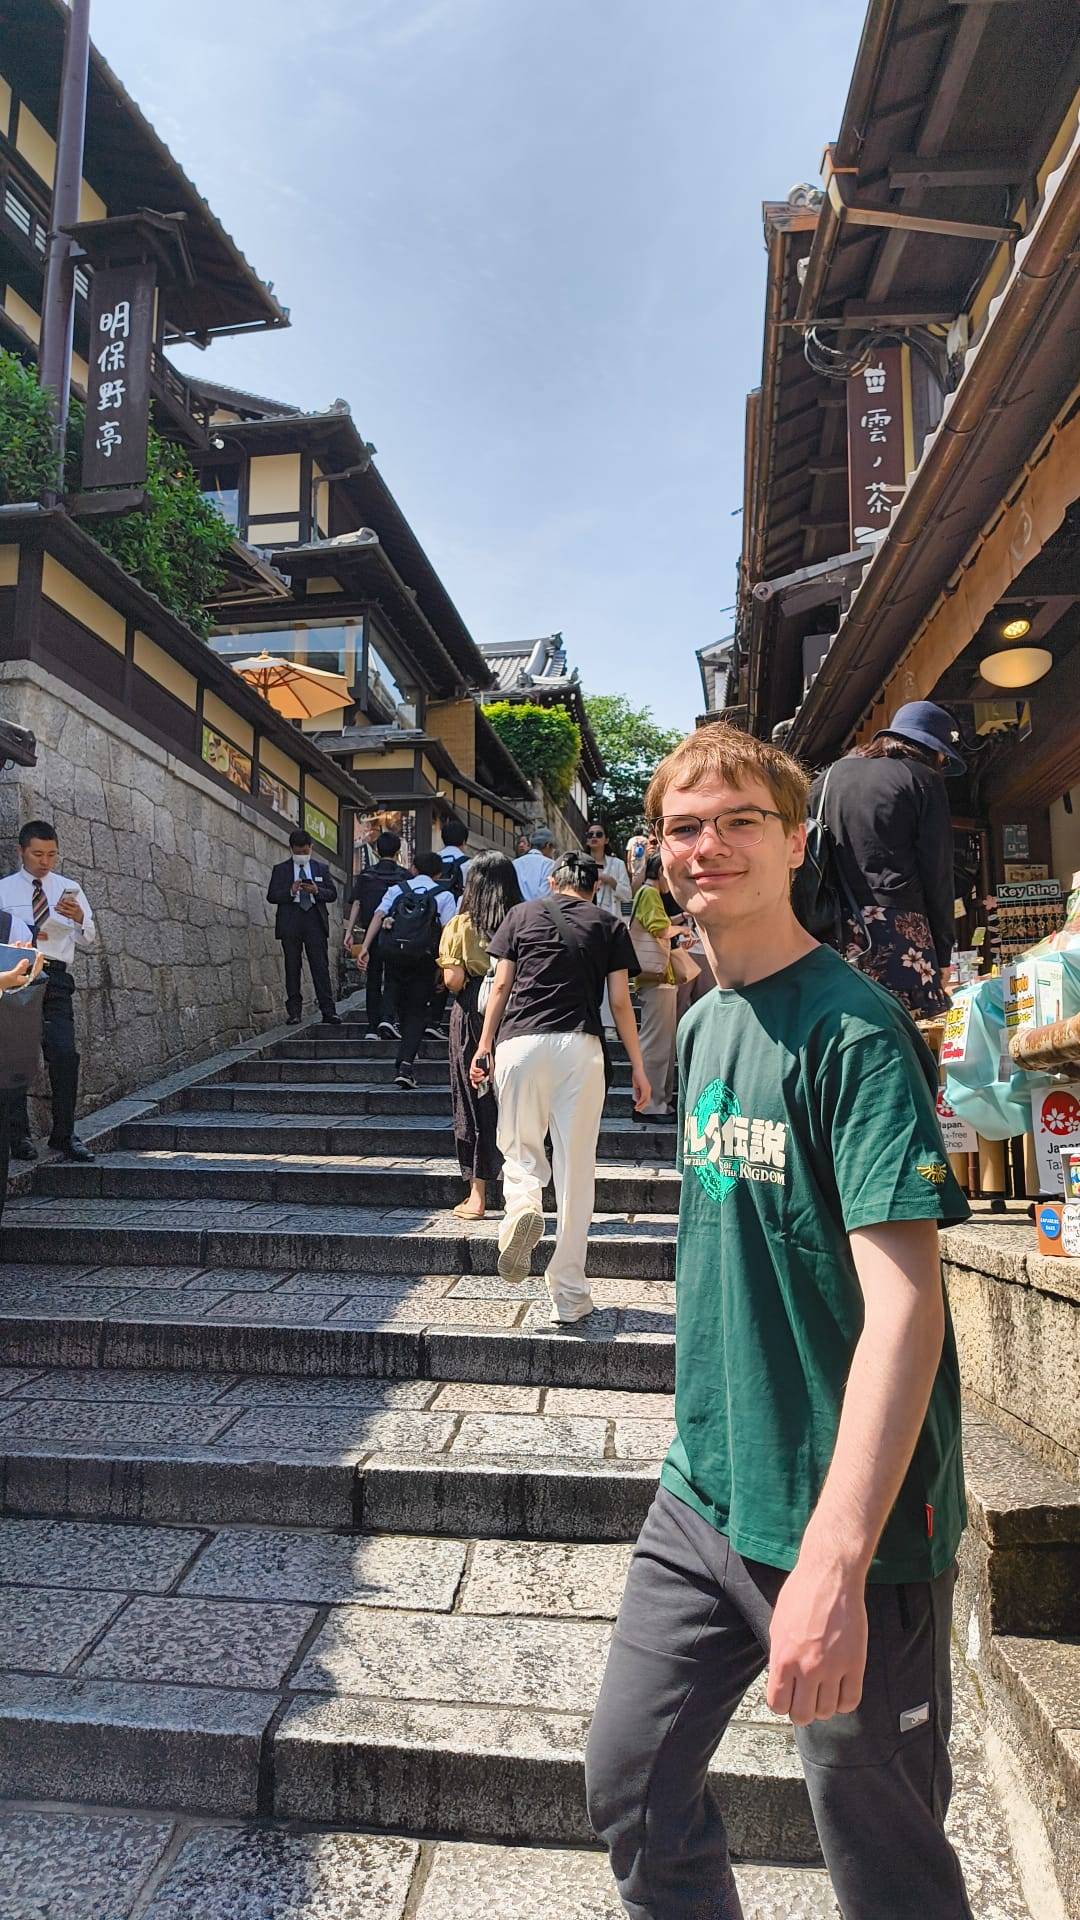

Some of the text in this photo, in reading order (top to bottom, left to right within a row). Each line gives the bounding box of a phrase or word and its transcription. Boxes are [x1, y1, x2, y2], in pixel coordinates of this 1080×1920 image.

[95, 300, 131, 458] 明保野亭
[860, 408, 893, 515] 雲ノ茶
[998, 885, 1058, 898] Key Ring
[940, 1121, 965, 1130] apan.
